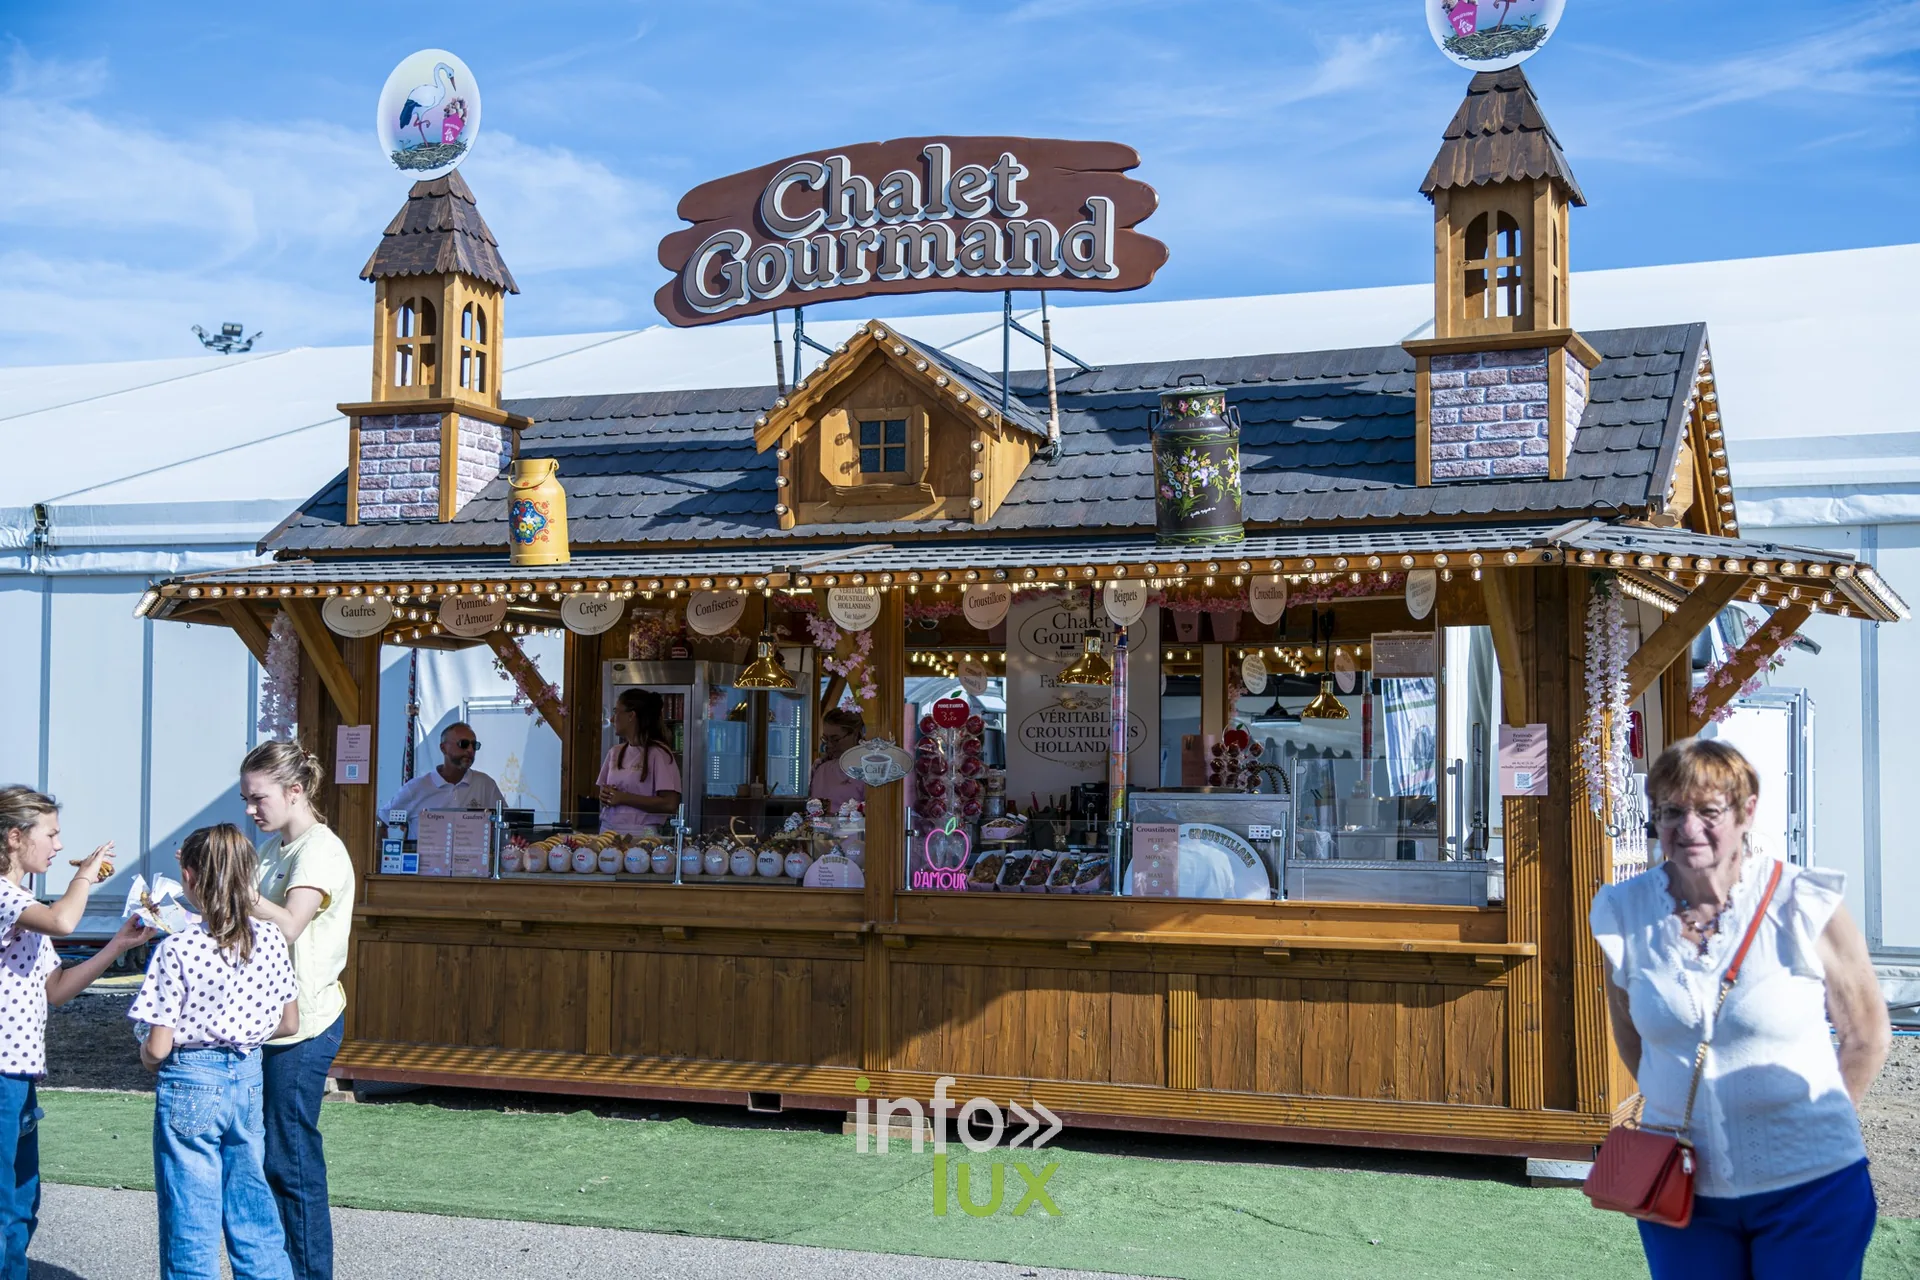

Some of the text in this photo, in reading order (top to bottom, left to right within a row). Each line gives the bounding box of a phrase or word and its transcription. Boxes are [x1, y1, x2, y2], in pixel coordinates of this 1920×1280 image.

[760, 143, 1028, 240] Chalet
[683, 195, 1120, 313] Gourmand
[456, 598, 492, 610] Pommes
[968, 592, 1007, 609] Croustillons
[1113, 589, 1138, 605] Beignets
[341, 605, 377, 618] Gaufres
[579, 600, 608, 618] Crêpes
[695, 596, 740, 616] Confiseries
[455, 612, 494, 626] d'Amour
[1053, 612, 1111, 629] Chaet
[1040, 709, 1111, 723] VÉRITABL
[1026, 726, 1139, 739] CROUSTILLS
[1136, 825, 1176, 833] Croustillons
[1188, 828, 1257, 869] CROUSTILLONS
[914, 871, 967, 890] D'AMOUR
